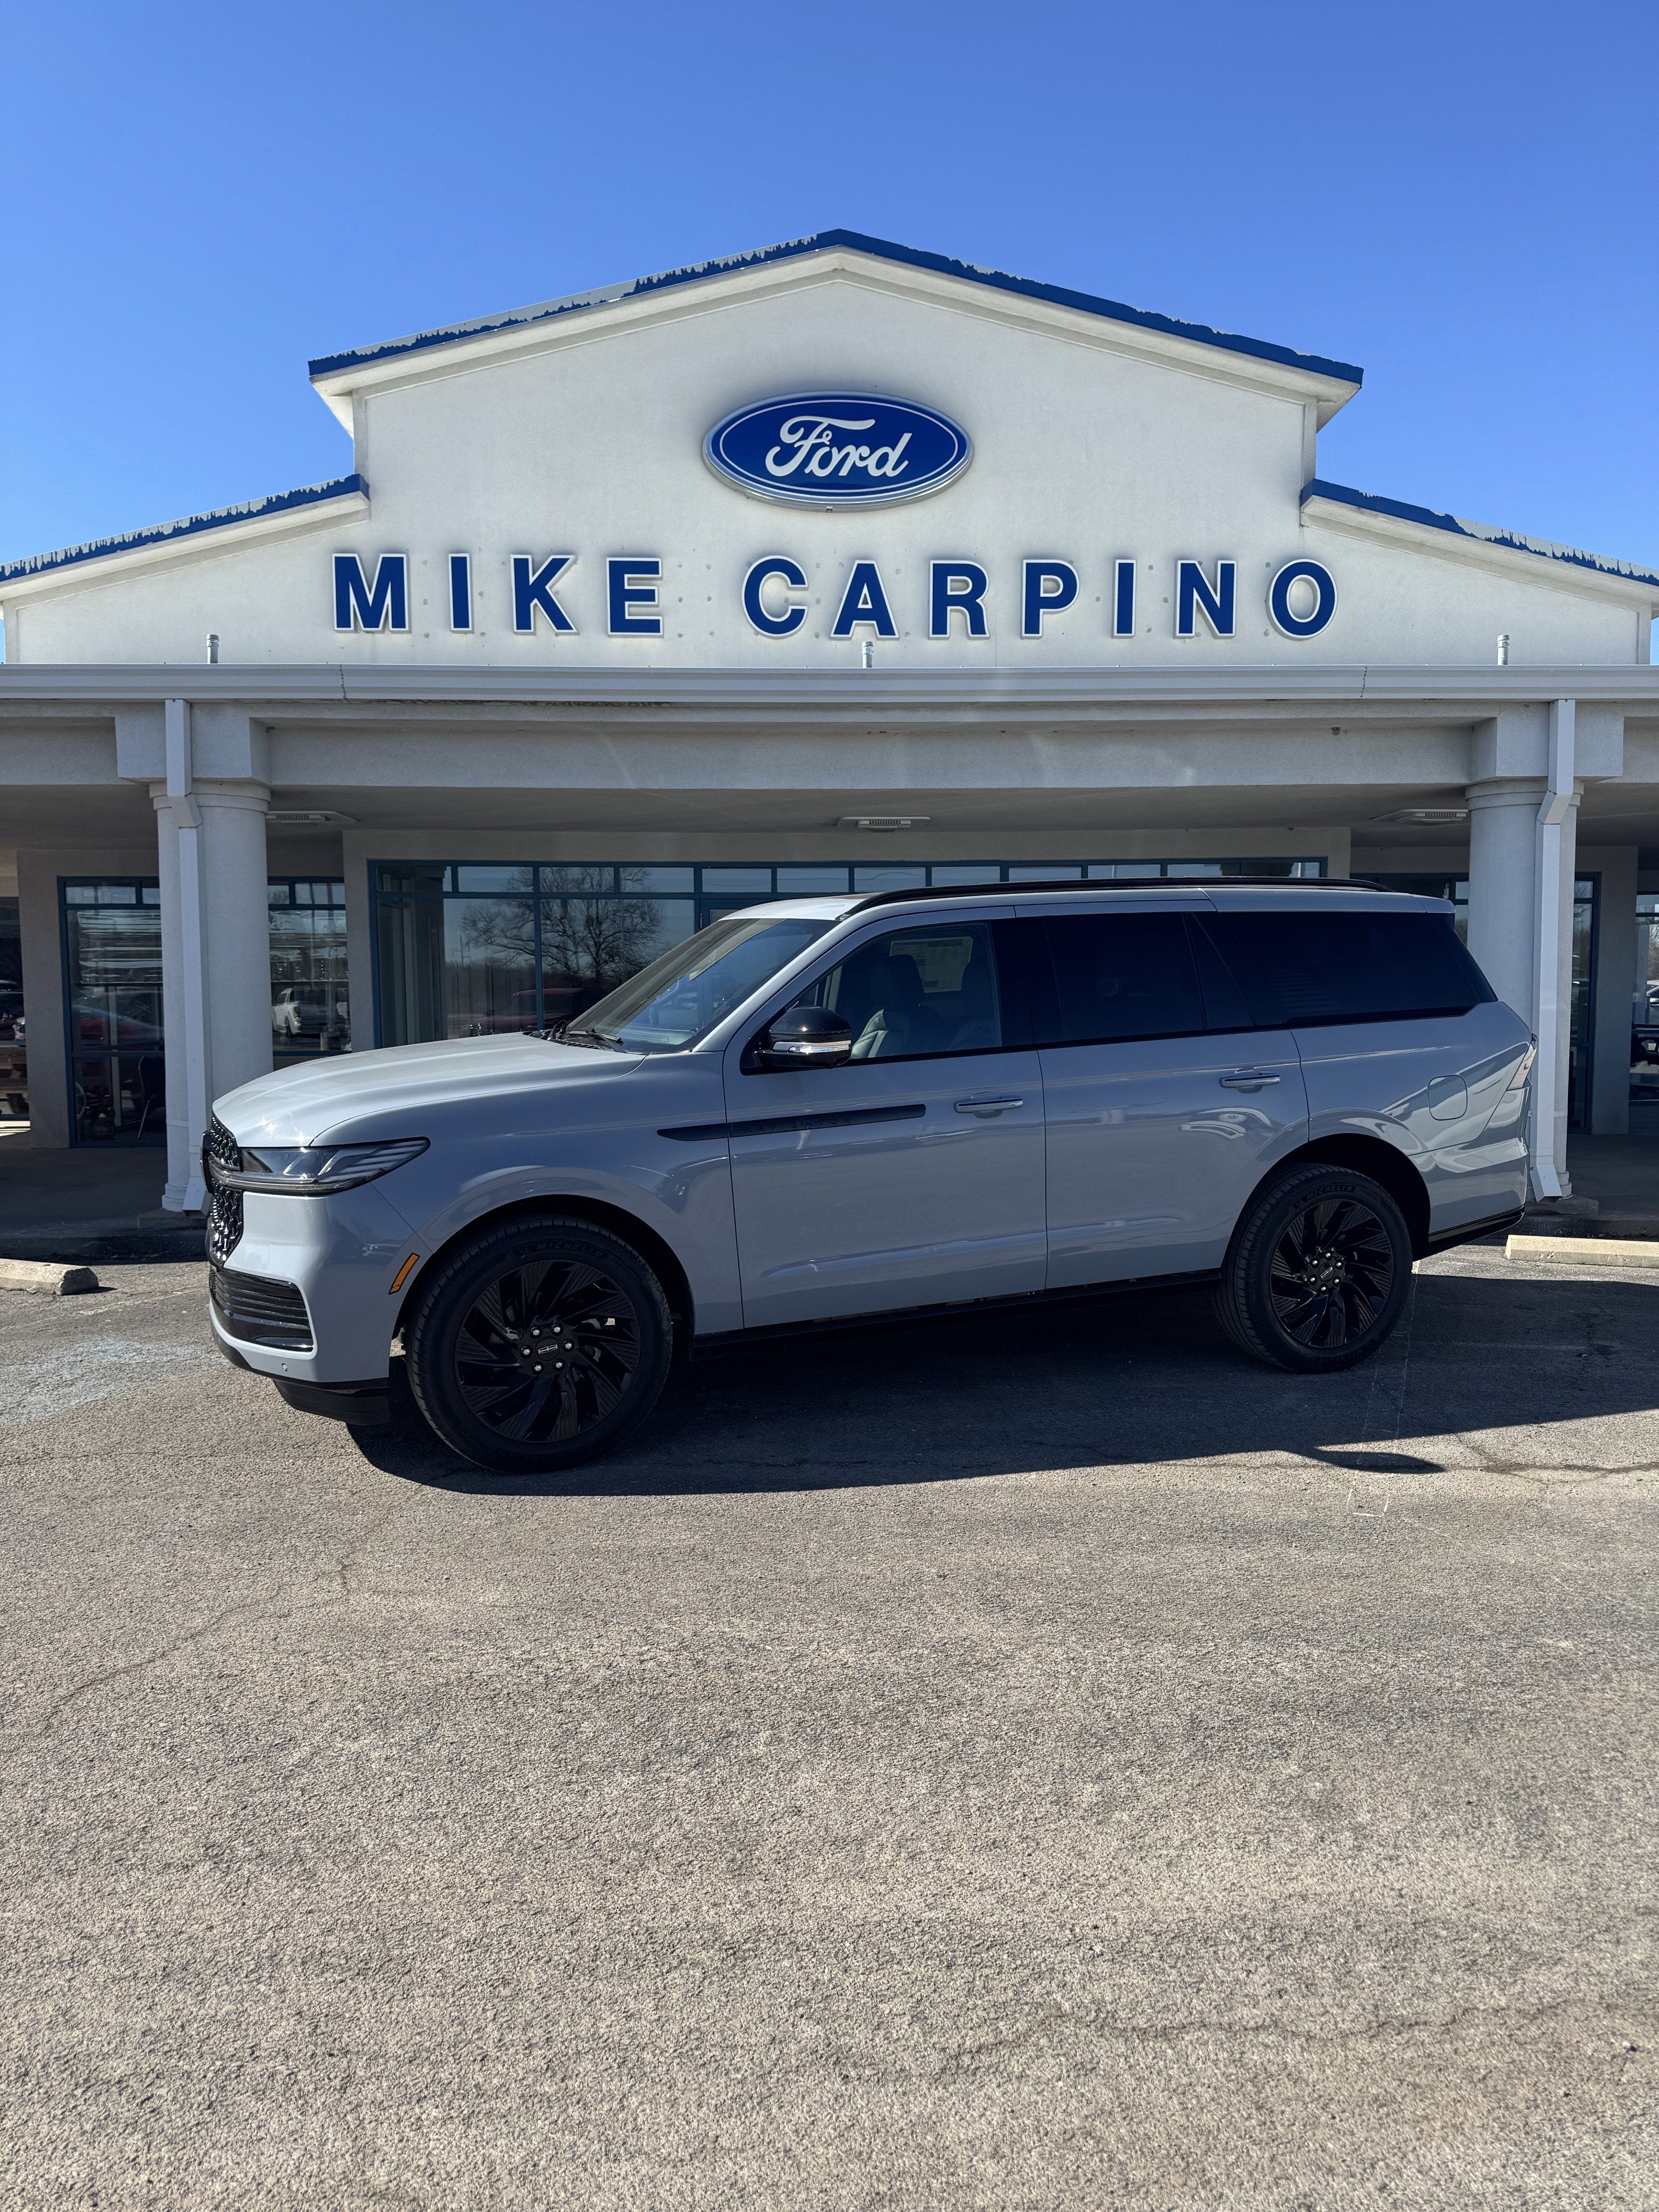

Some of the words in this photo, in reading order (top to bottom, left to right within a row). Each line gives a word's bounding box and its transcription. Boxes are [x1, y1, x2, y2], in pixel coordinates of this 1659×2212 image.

[765, 415, 912, 477] Ford
[334, 556, 663, 634] MIKE
[742, 557, 1336, 637] CARPINO
[743, 1117, 850, 1133] NAVIGATOR
[1306, 1185, 1353, 1200] MICHELIN
[536, 1242, 605, 1257] MICHELIN
